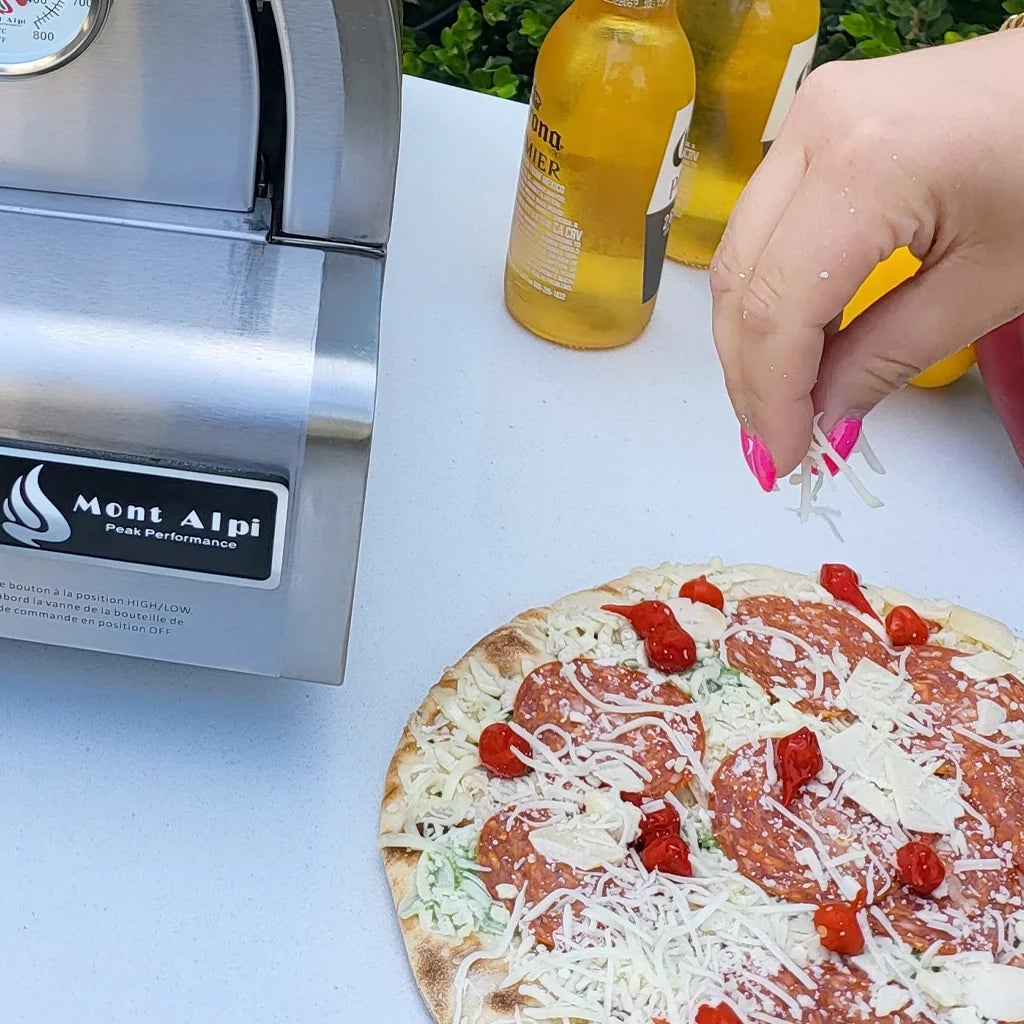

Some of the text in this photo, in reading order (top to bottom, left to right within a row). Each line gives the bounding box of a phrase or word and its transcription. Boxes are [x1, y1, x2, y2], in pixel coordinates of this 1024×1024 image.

[33, 30, 54, 41] 800
[553, 222, 563, 235] CA
[565, 227, 583, 240] CRV
[73, 493, 261, 538] Mont Alpi
[105, 522, 237, 550] Peak Performance
[9, 582, 50, 594] bouton
[53, 588, 60, 596] à
[64, 589, 73, 597] la
[76, 592, 124, 605] position
[127, 598, 193, 615] HIGH/LOW.
[33, 597, 43, 605] la
[46, 600, 80, 611] vanne
[83, 604, 97, 613] de
[101, 607, 111, 615] la
[114, 608, 166, 623] bouteille
[169, 617, 184, 625] de
[14, 607, 77, 623] commande
[81, 617, 95, 625] en
[99, 620, 146, 633] position
